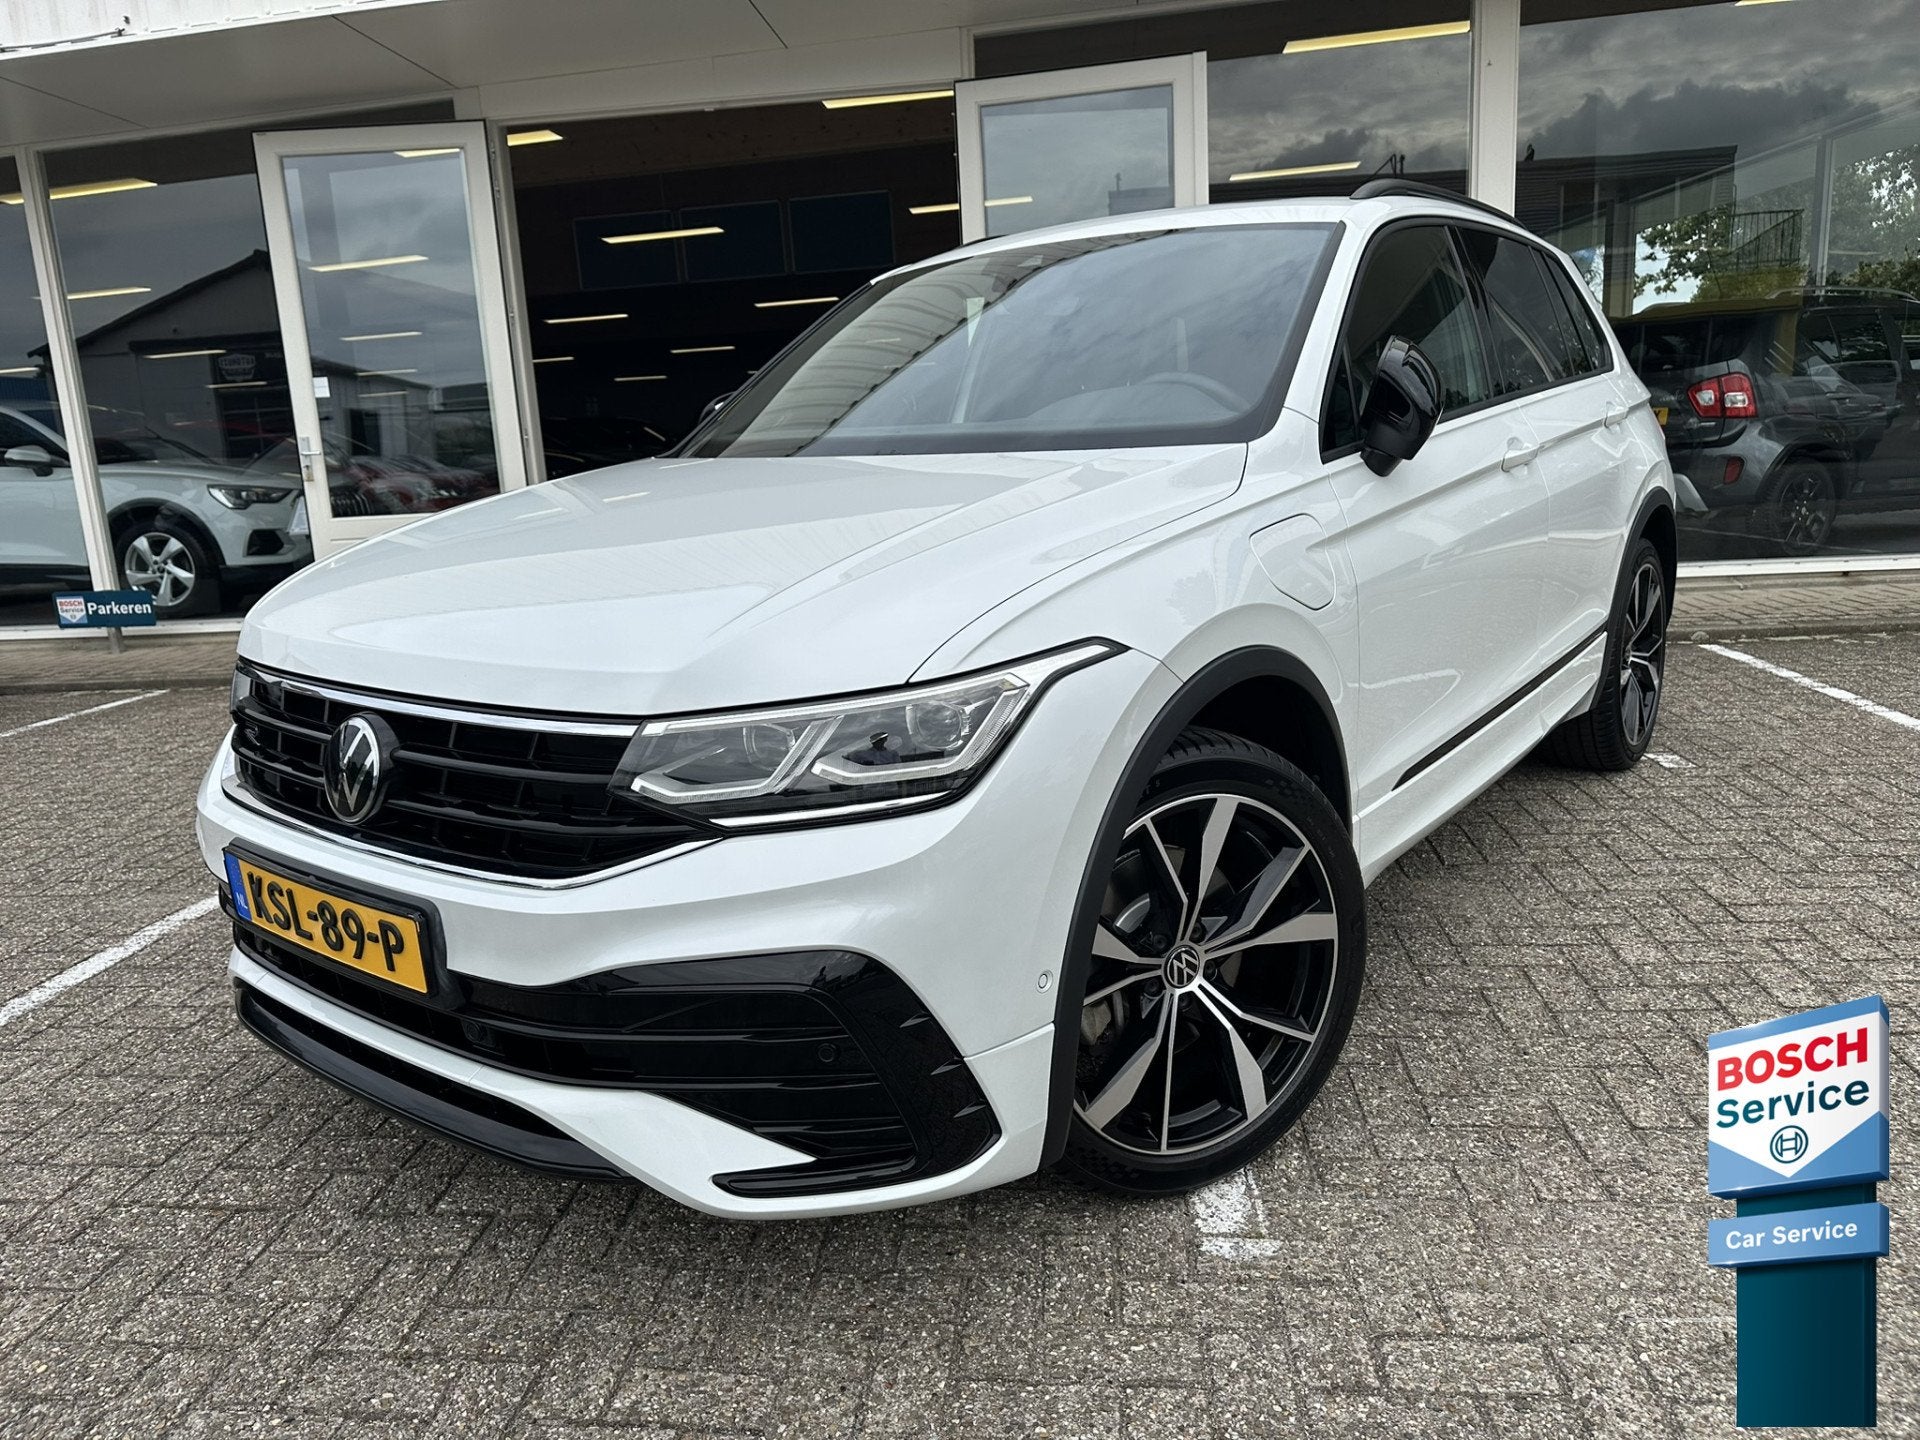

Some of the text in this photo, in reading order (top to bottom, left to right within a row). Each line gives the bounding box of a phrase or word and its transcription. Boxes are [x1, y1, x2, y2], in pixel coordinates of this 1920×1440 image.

[58, 600, 83, 608] BOSCH
[87, 601, 152, 615] Parkeren
[237, 893, 248, 910] NL
[246, 872, 405, 972] KSL-89-P
